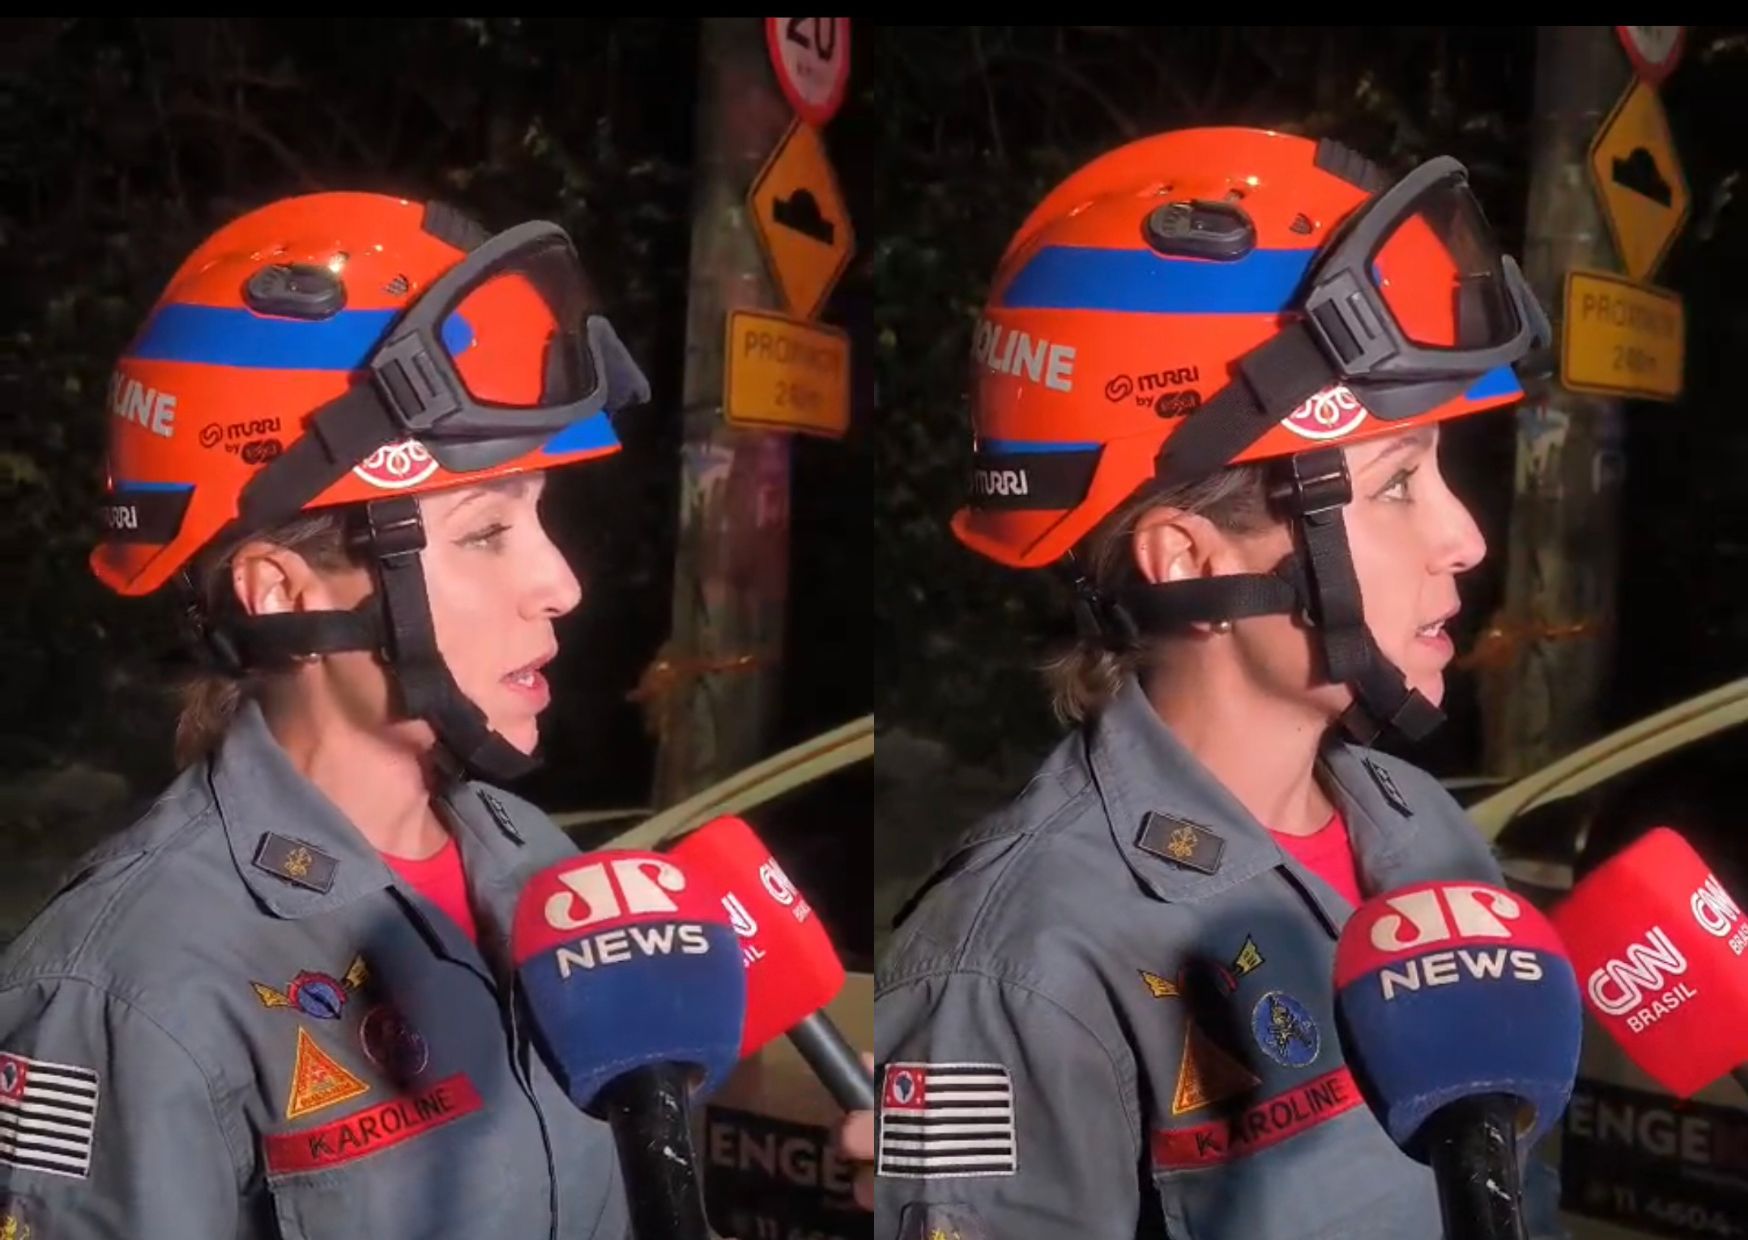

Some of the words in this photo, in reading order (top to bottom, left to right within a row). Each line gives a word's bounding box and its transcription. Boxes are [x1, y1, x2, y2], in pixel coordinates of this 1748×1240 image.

[1136, 394, 1154, 408] by
[1137, 366, 1199, 392] ITURRI
[225, 442, 241, 456] by
[1690, 873, 1741, 937] CNN
[556, 923, 709, 980] NEWS
[1379, 947, 1543, 1001] NEWS
[1587, 925, 1688, 1016] CNN
[1626, 984, 1697, 1033] BRASIL
[308, 1087, 453, 1160] KAROLINE
